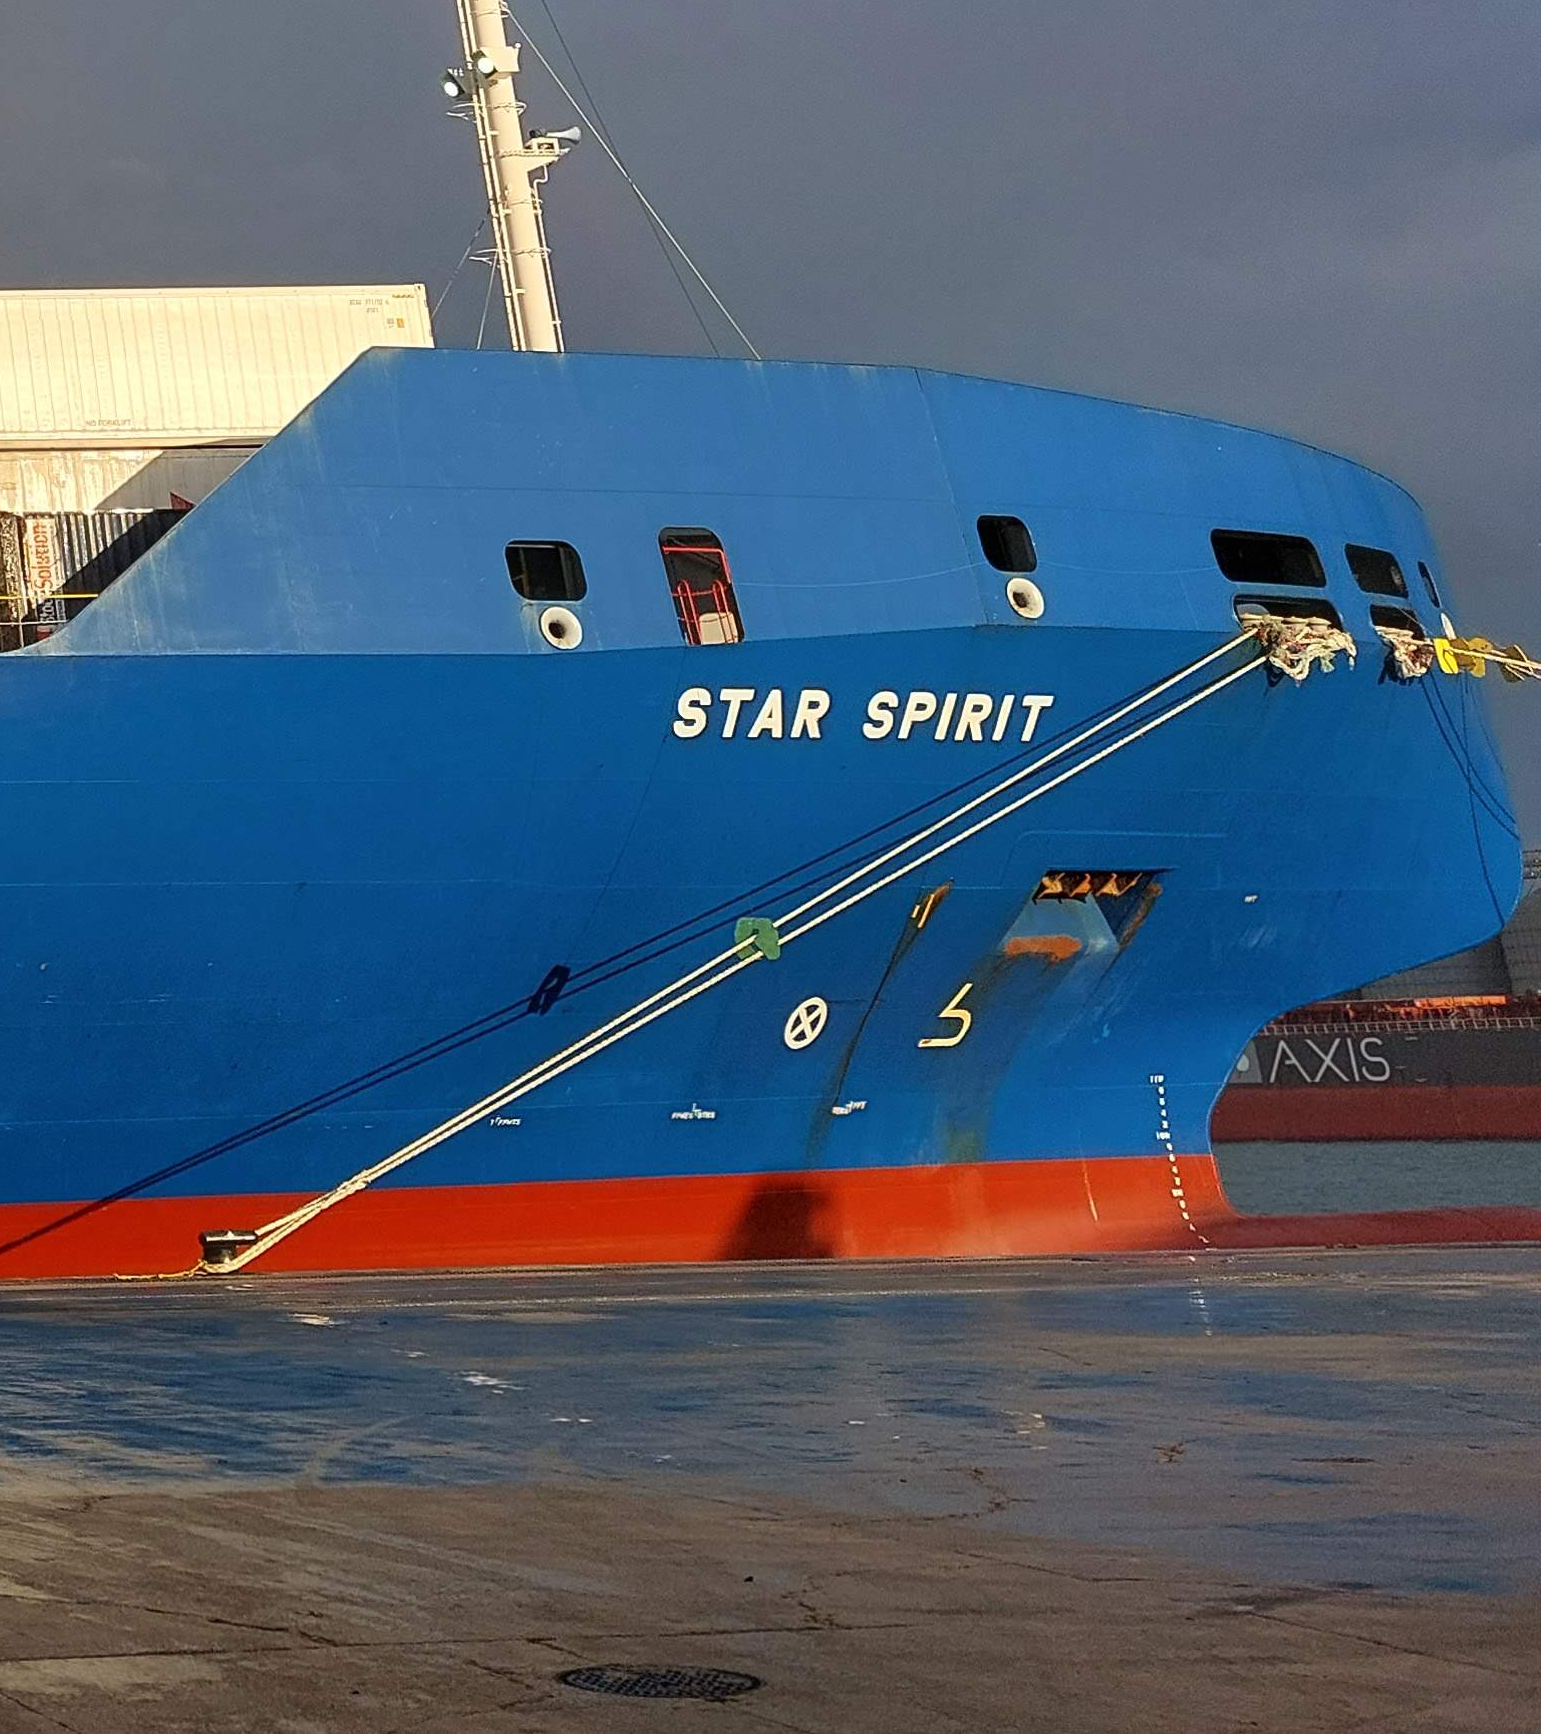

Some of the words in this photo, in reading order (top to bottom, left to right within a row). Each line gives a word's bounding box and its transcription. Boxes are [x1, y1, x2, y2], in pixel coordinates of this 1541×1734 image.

[672, 687, 831, 739] STAR
[862, 690, 1055, 742] SPIRIT
[1269, 1036, 1391, 1083] AXIS
